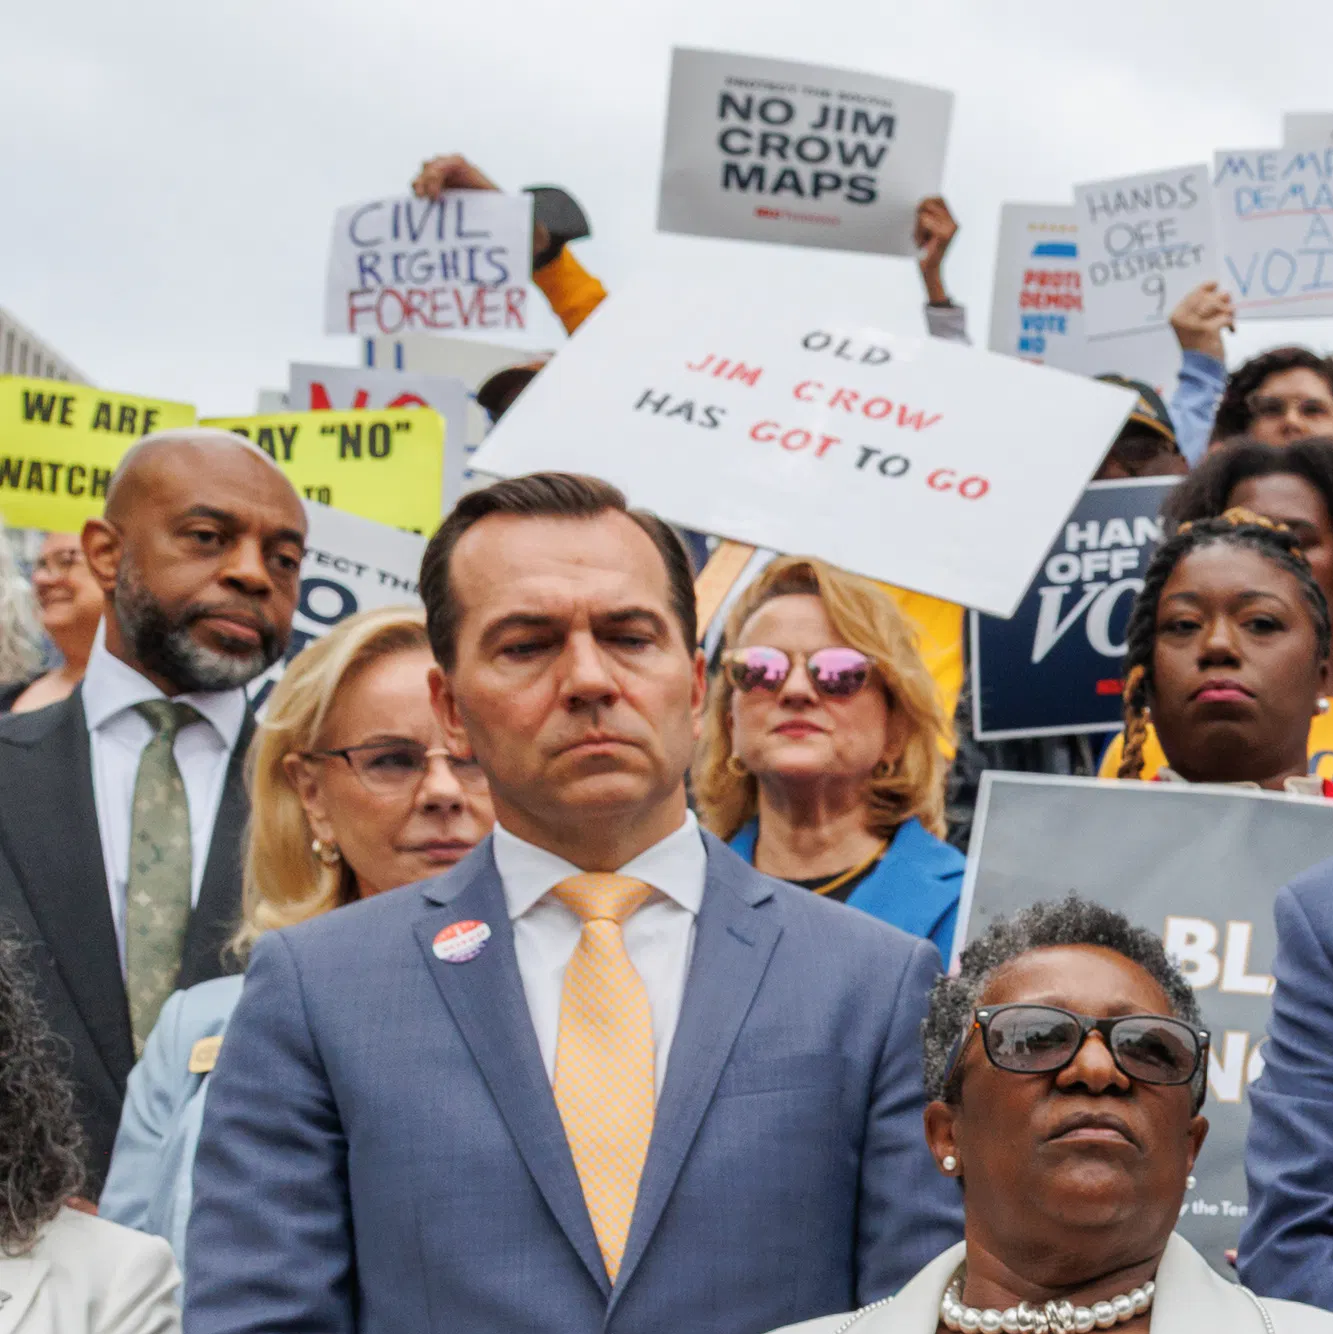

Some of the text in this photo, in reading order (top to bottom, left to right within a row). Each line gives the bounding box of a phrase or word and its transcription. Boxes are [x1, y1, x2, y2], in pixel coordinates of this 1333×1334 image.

[718, 91, 896, 139] NO JIM
[718, 127, 887, 169] CROW
[720, 162, 878, 206] MAPS
[1086, 173, 1199, 225] HANDS
[349, 198, 493, 248] CIVIL
[1103, 217, 1179, 257] OFF
[346, 285, 528, 335] FOREVER
[800, 329, 891, 366] OLD
[21, 389, 162, 436] WE ARE
[684, 353, 942, 432] JIM CROW
[633, 387, 991, 501] HAS GOT TO GO
[1044, 548, 1139, 583] OFF
[1191, 1199, 1219, 1216] the
